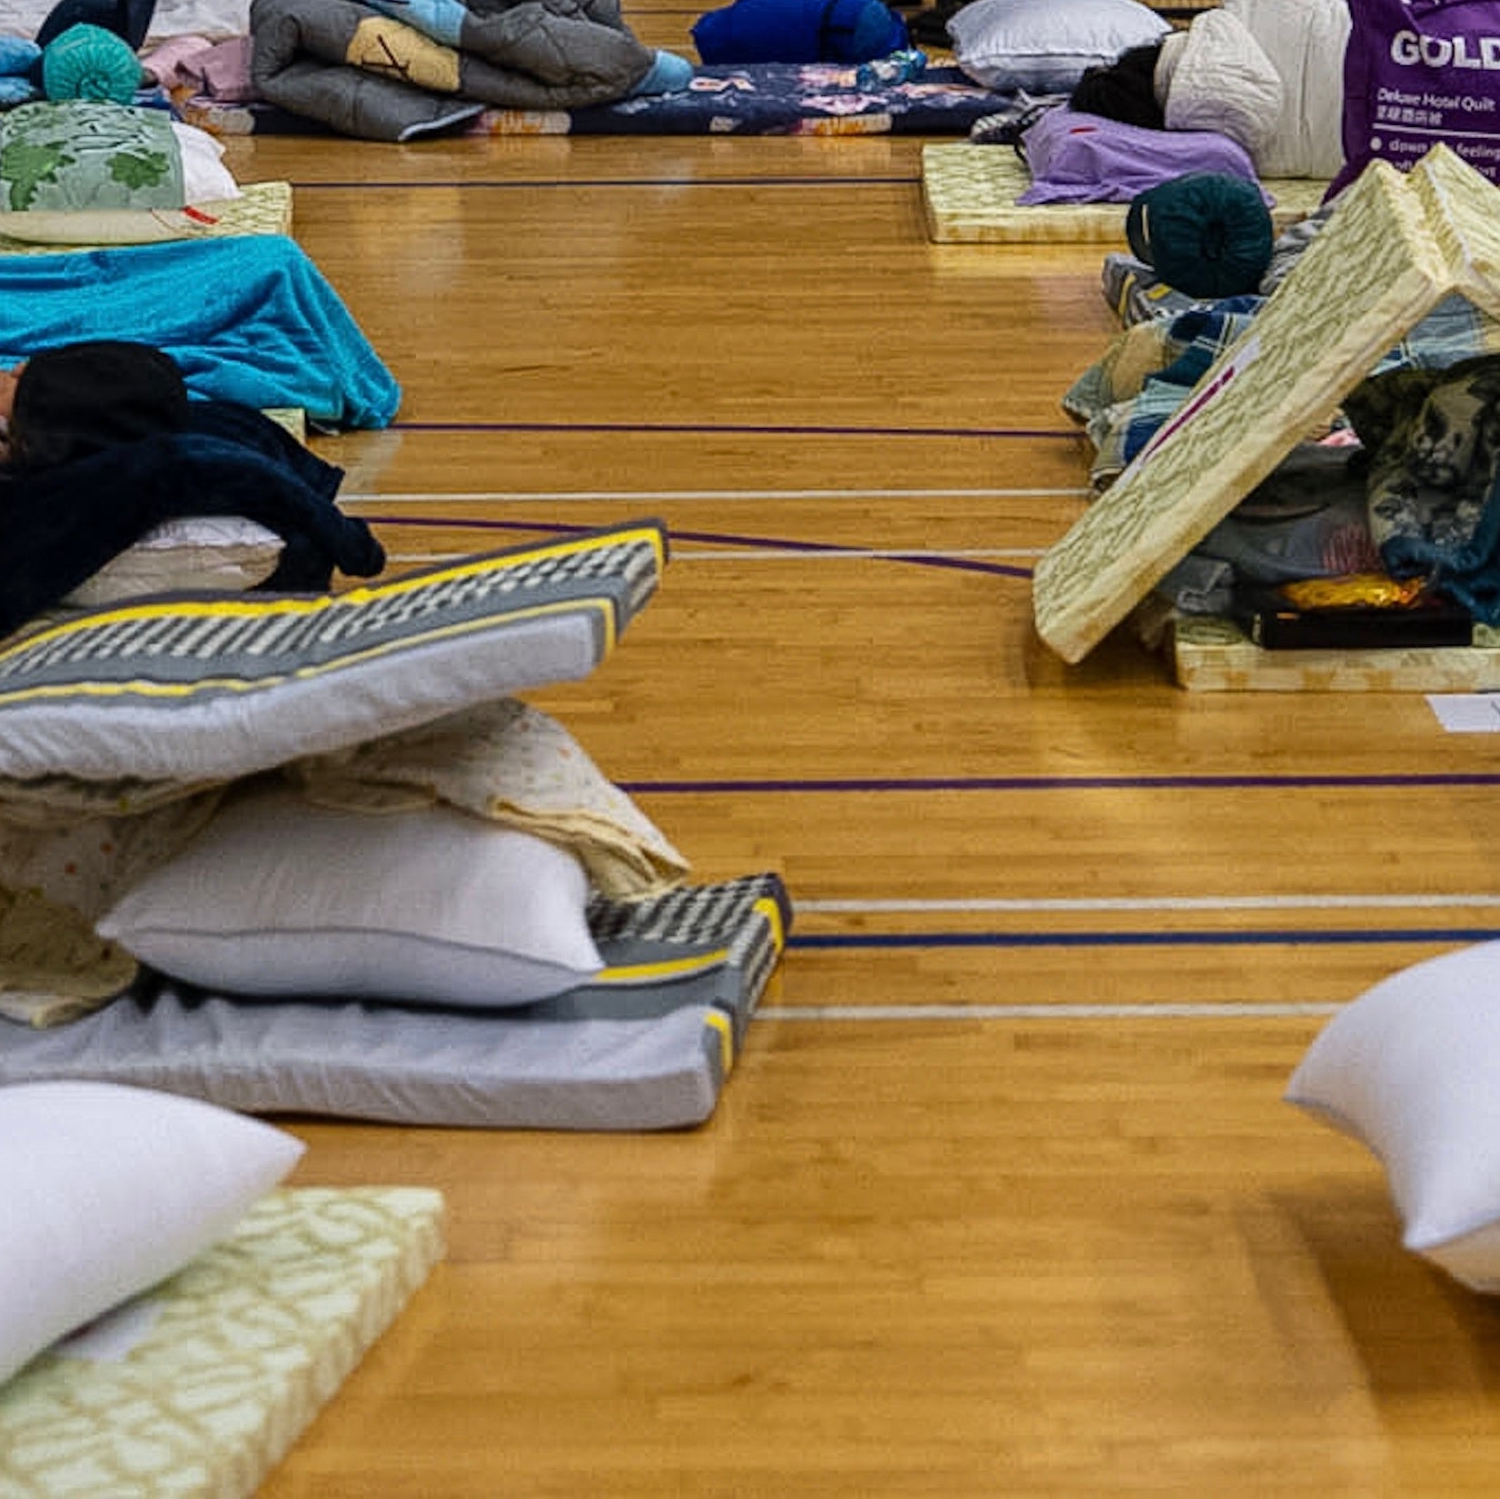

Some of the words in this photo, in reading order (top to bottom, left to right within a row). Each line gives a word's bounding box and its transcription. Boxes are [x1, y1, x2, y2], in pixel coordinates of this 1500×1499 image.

[1377, 87, 1421, 106] Deluxe
[1422, 93, 1460, 108] Hotel
[1461, 96, 1496, 111] Quilt
